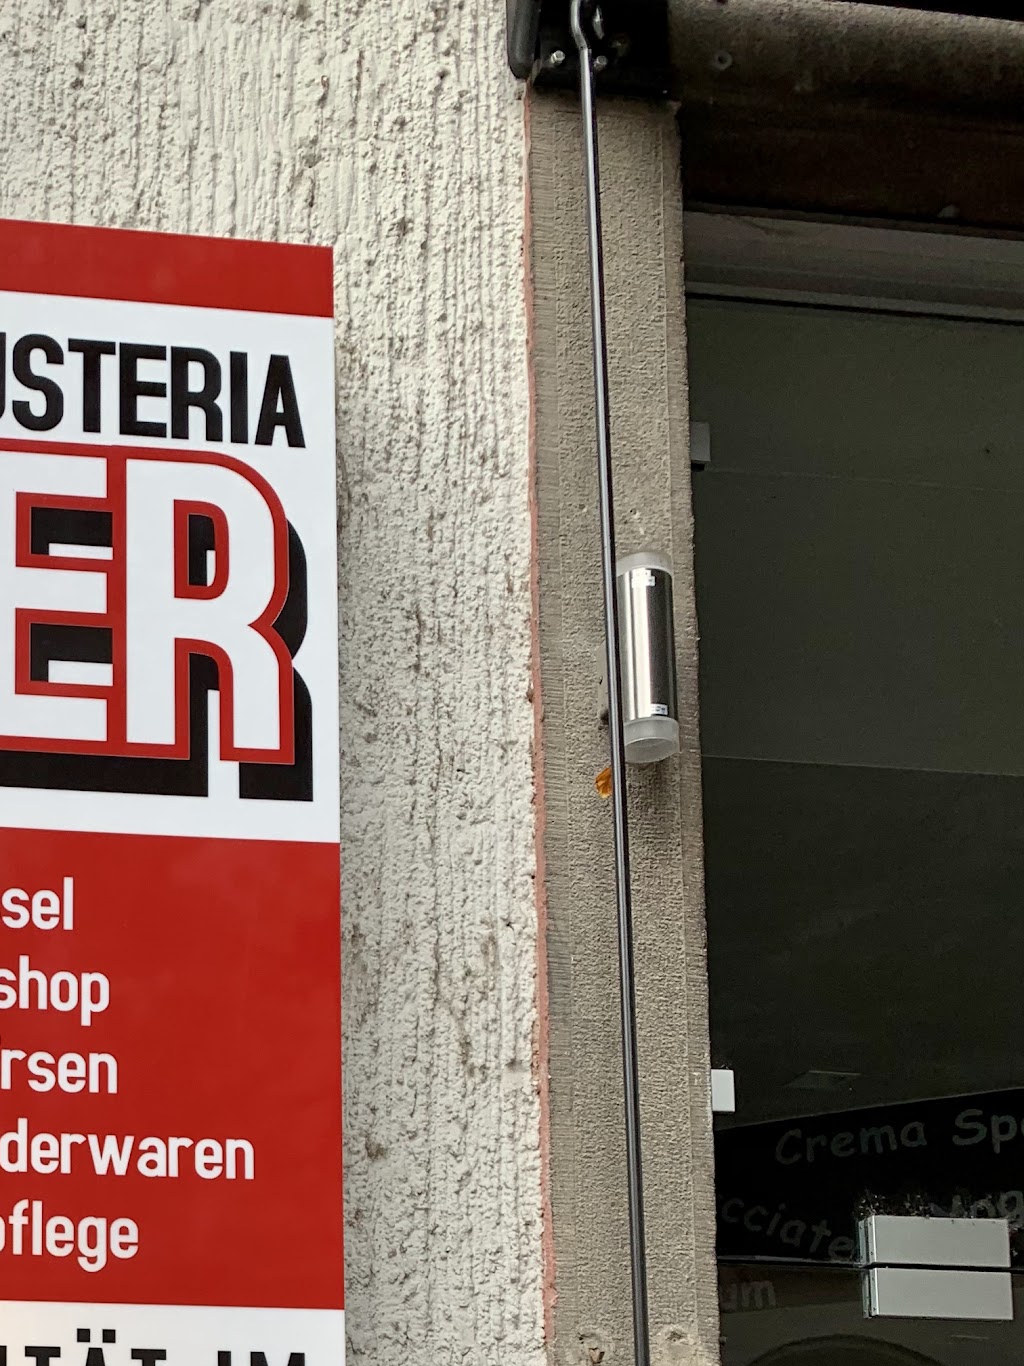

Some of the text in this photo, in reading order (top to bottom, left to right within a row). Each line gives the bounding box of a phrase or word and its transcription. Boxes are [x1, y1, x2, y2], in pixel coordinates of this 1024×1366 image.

[775, 1108, 1024, 1165] Crema Sp
[718, 1193, 856, 1261] cciate
